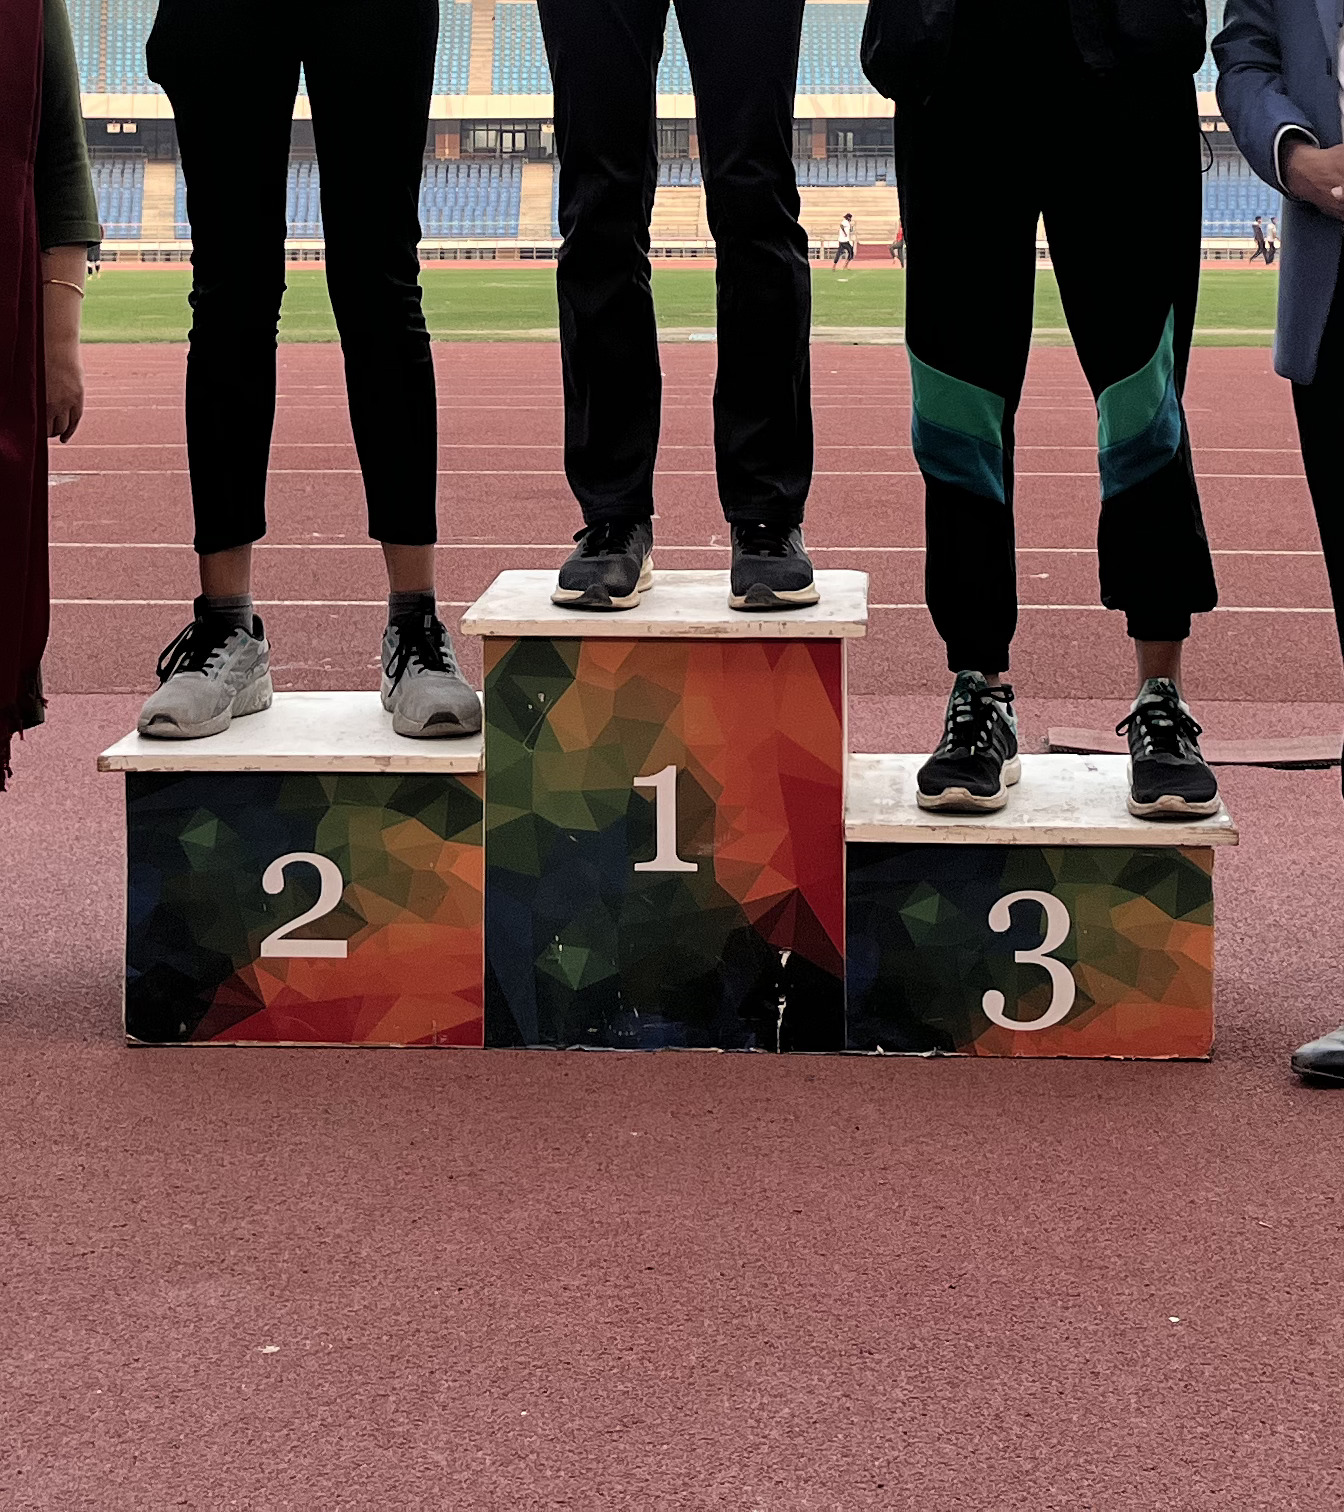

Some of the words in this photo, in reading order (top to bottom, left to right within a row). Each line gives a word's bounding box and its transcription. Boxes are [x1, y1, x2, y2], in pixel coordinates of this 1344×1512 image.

[634, 766, 697, 871] 1
[261, 853, 347, 958] 2
[983, 891, 1075, 1030] 3
